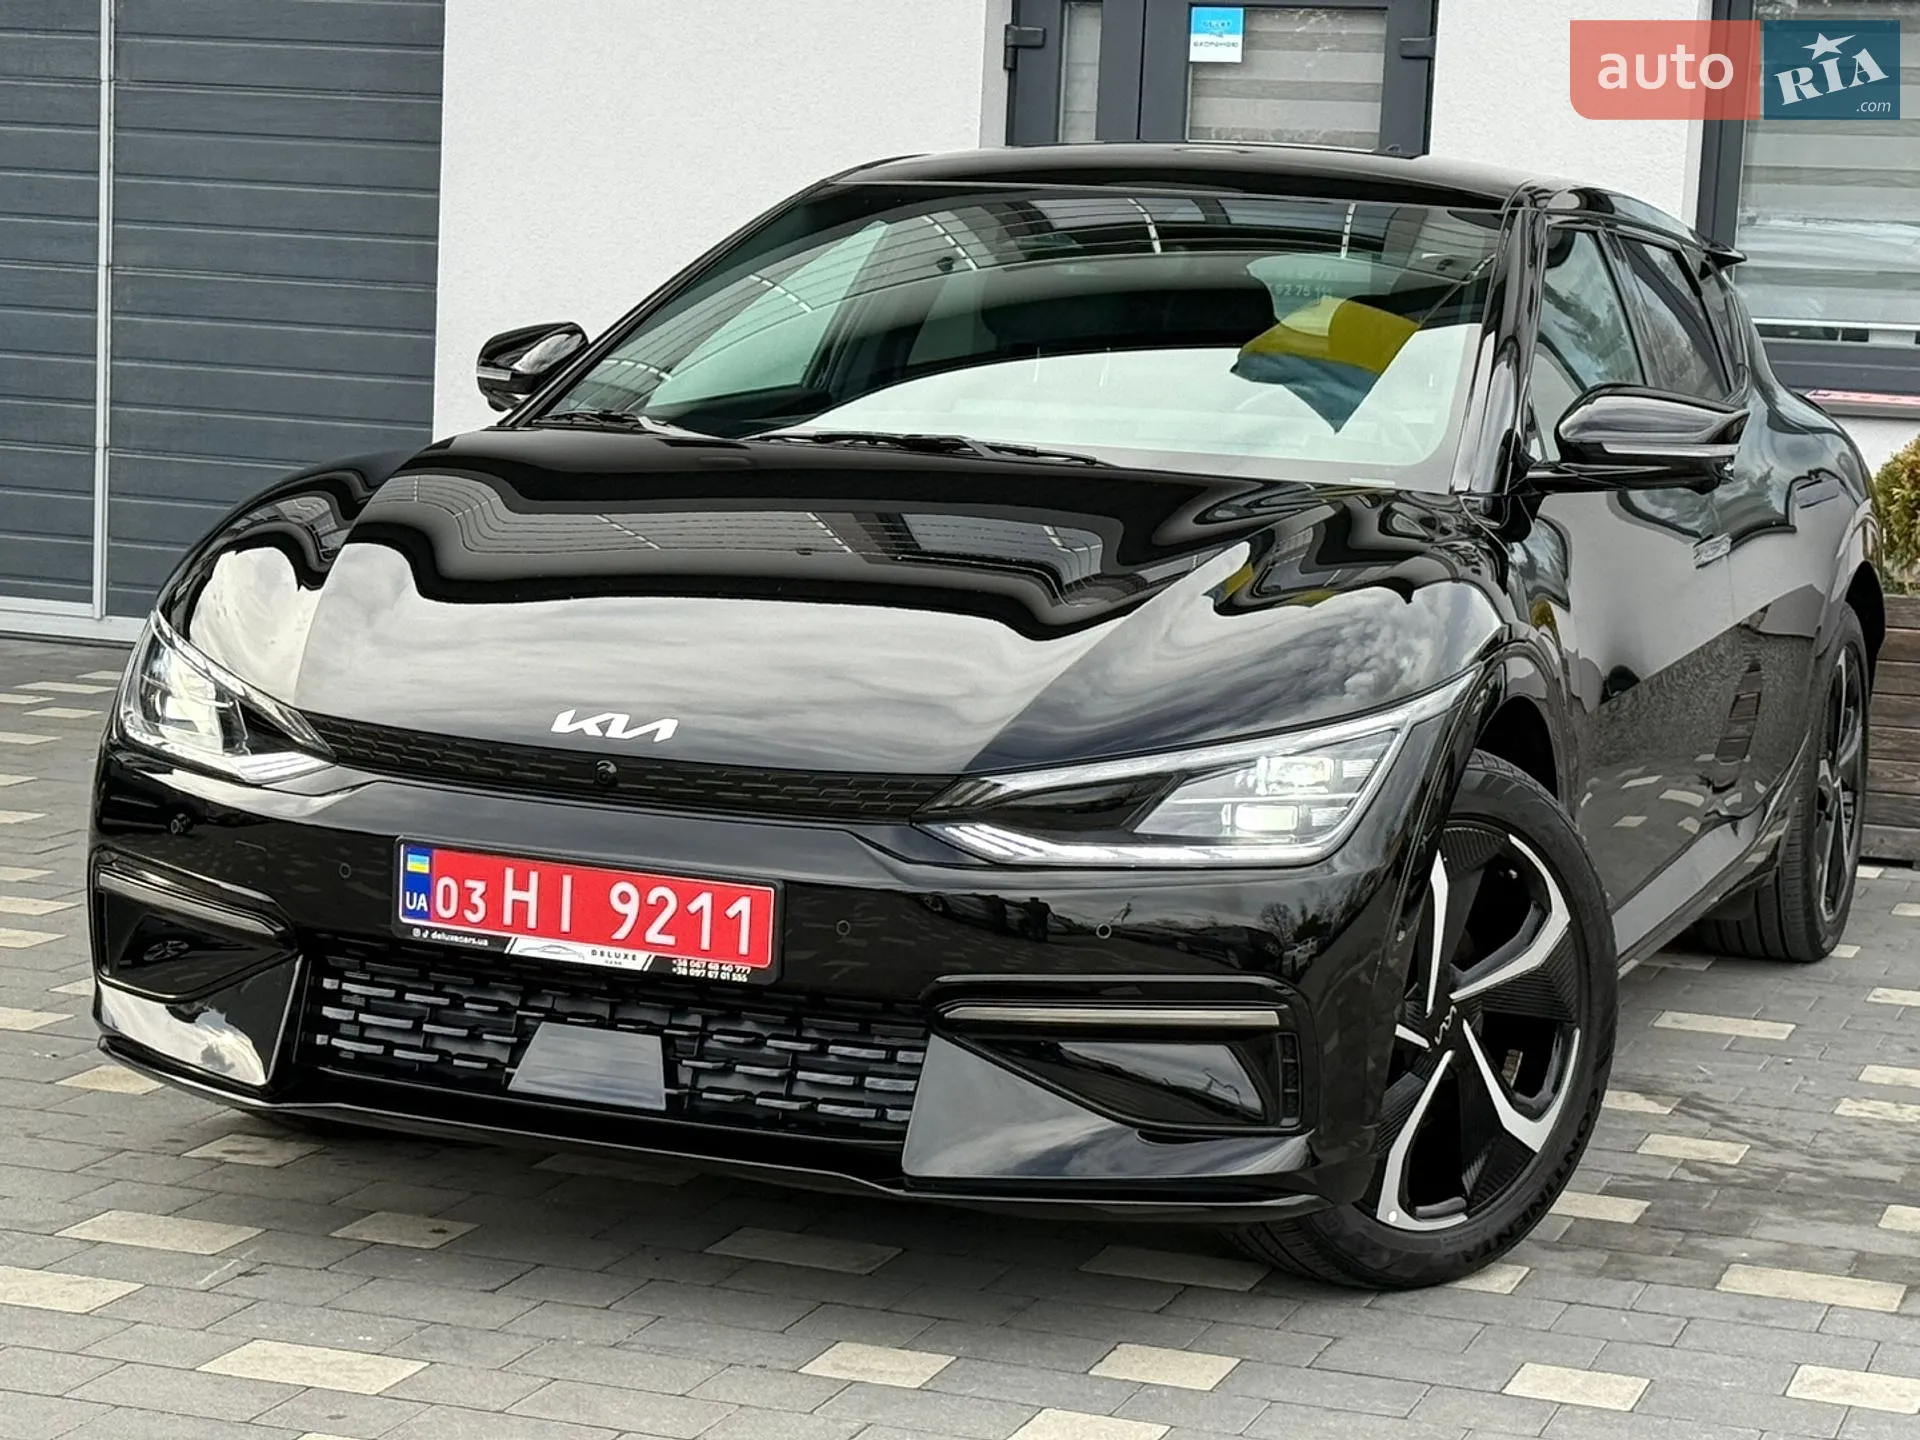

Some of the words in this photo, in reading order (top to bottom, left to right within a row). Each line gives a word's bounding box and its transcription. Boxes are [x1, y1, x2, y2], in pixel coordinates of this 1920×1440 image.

[550, 708, 679, 743] KIA
[405, 890, 429, 912] UA
[434, 876, 488, 924] 03
[608, 880, 752, 956] 9211
[591, 949, 637, 961] DELUXE
